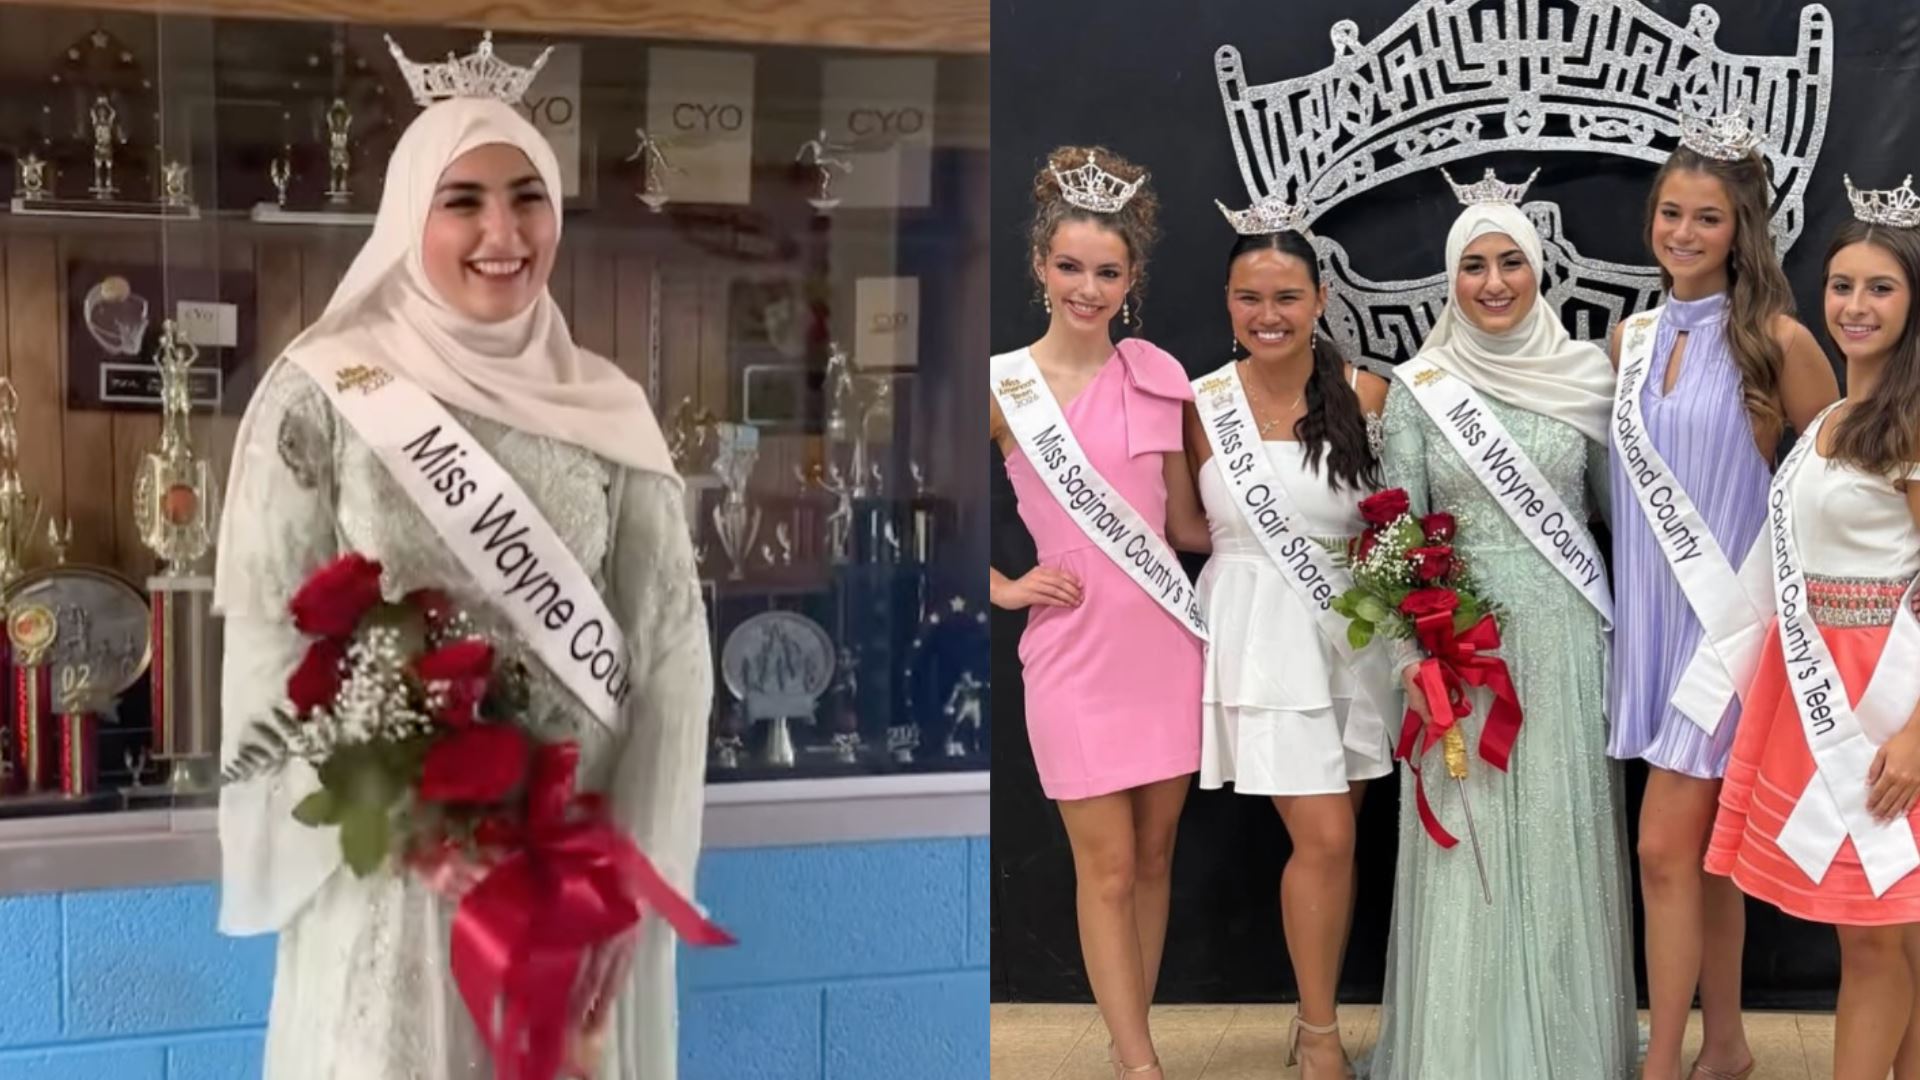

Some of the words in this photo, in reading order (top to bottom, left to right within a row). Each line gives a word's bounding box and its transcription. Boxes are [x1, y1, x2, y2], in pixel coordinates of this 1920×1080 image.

[672, 103, 743, 131] CYO
[847, 107, 924, 136] CYO
[402, 425, 477, 507] Miss
[470, 493, 575, 630] Wayne
[1032, 424, 1067, 470] Miss
[1059, 465, 1130, 543] Saginaw
[1125, 534, 1183, 604] County's
[1213, 408, 1244, 455] Miss
[1230, 453, 1257, 486] St.
[1245, 484, 1290, 539] Clair
[1281, 536, 1335, 611] Shores
[1446, 398, 1487, 447] Miss
[1482, 438, 1545, 518] Wayne
[1541, 512, 1600, 587] County
[1617, 400, 1662, 487] Oakland
[1649, 486, 1702, 564] County
[1771, 489, 1795, 582] Oakland
[1781, 583, 1820, 681] County's
[1804, 679, 1835, 736] Teen
